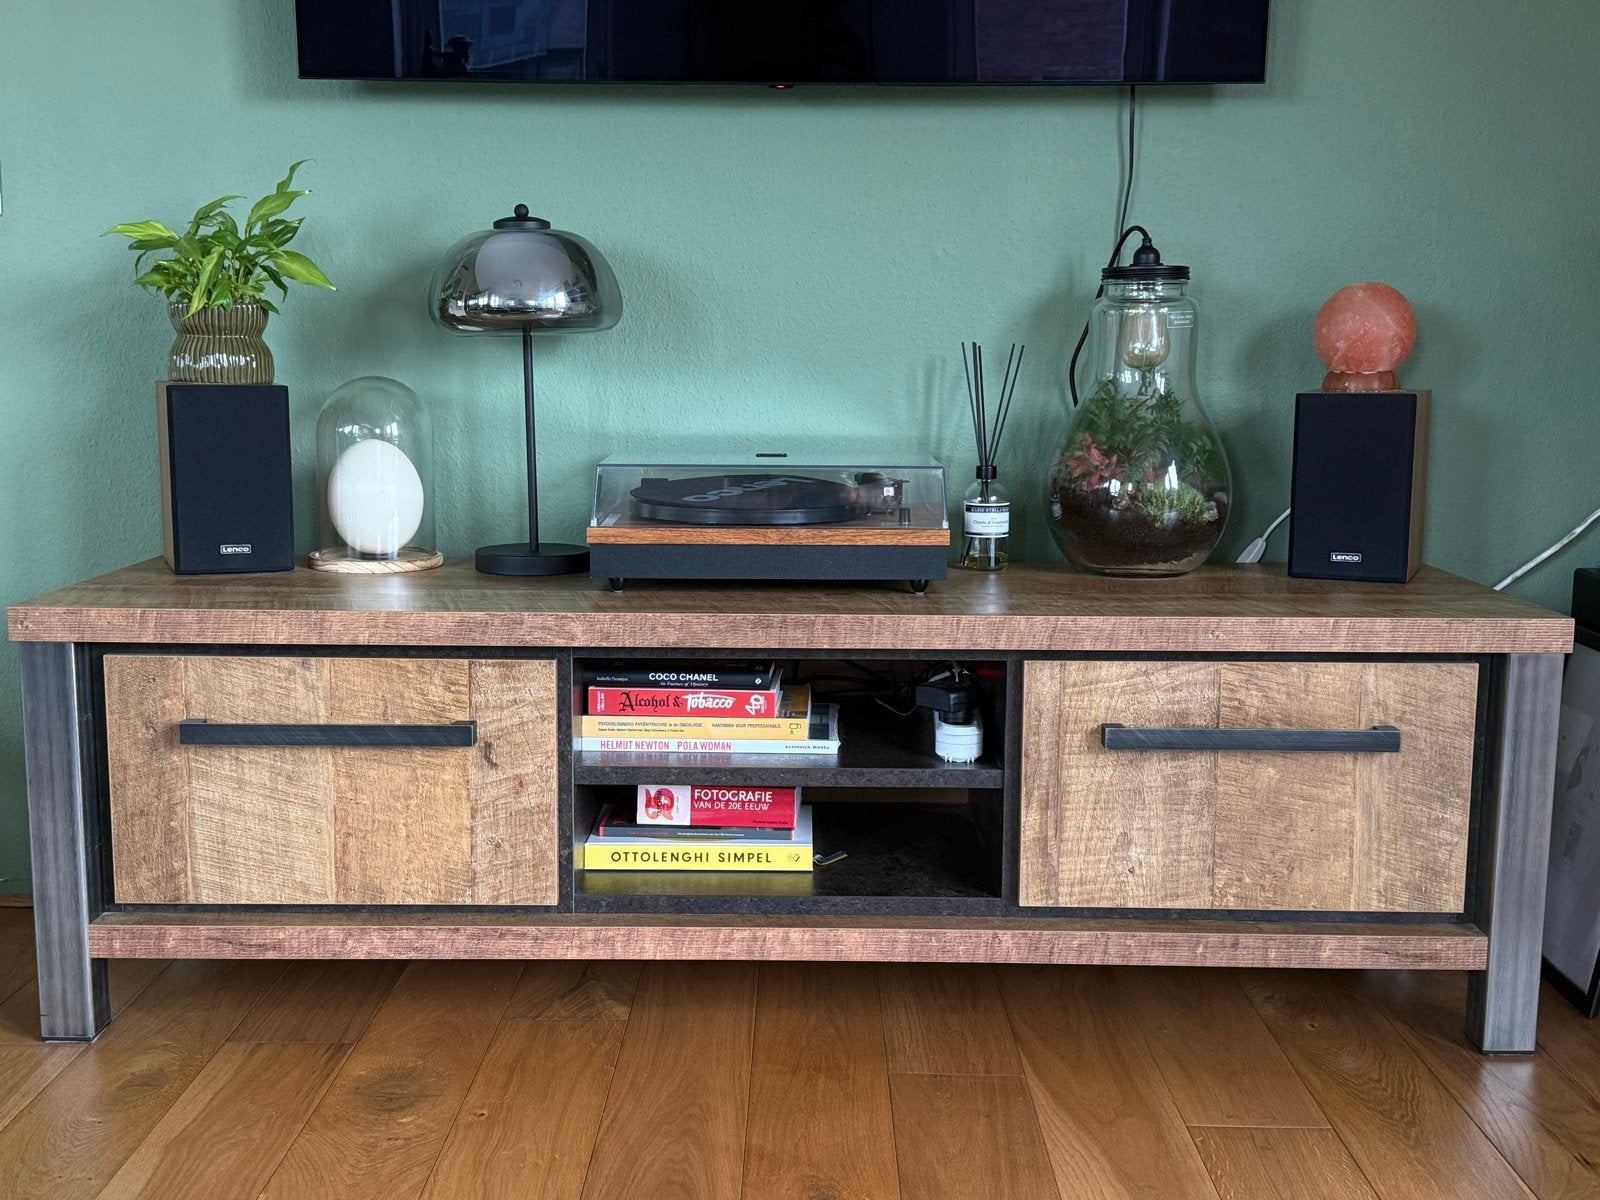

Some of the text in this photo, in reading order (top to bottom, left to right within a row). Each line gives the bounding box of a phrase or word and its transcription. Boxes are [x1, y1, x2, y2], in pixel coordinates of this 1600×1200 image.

[648, 672, 718, 681] COCO CHANEL
[619, 690, 670, 712] Alcohol
[672, 695, 684, 708] &
[682, 692, 737, 713] Tobacco
[745, 694, 763, 715] 40
[600, 740, 732, 751] HELMUT NEWTON POLA WOMAN
[694, 789, 773, 803] FOTOGRAFIE
[694, 801, 769, 812] VAN DE 20E EEUW
[611, 851, 772, 863] OTTOLENGHI SIMPEL
